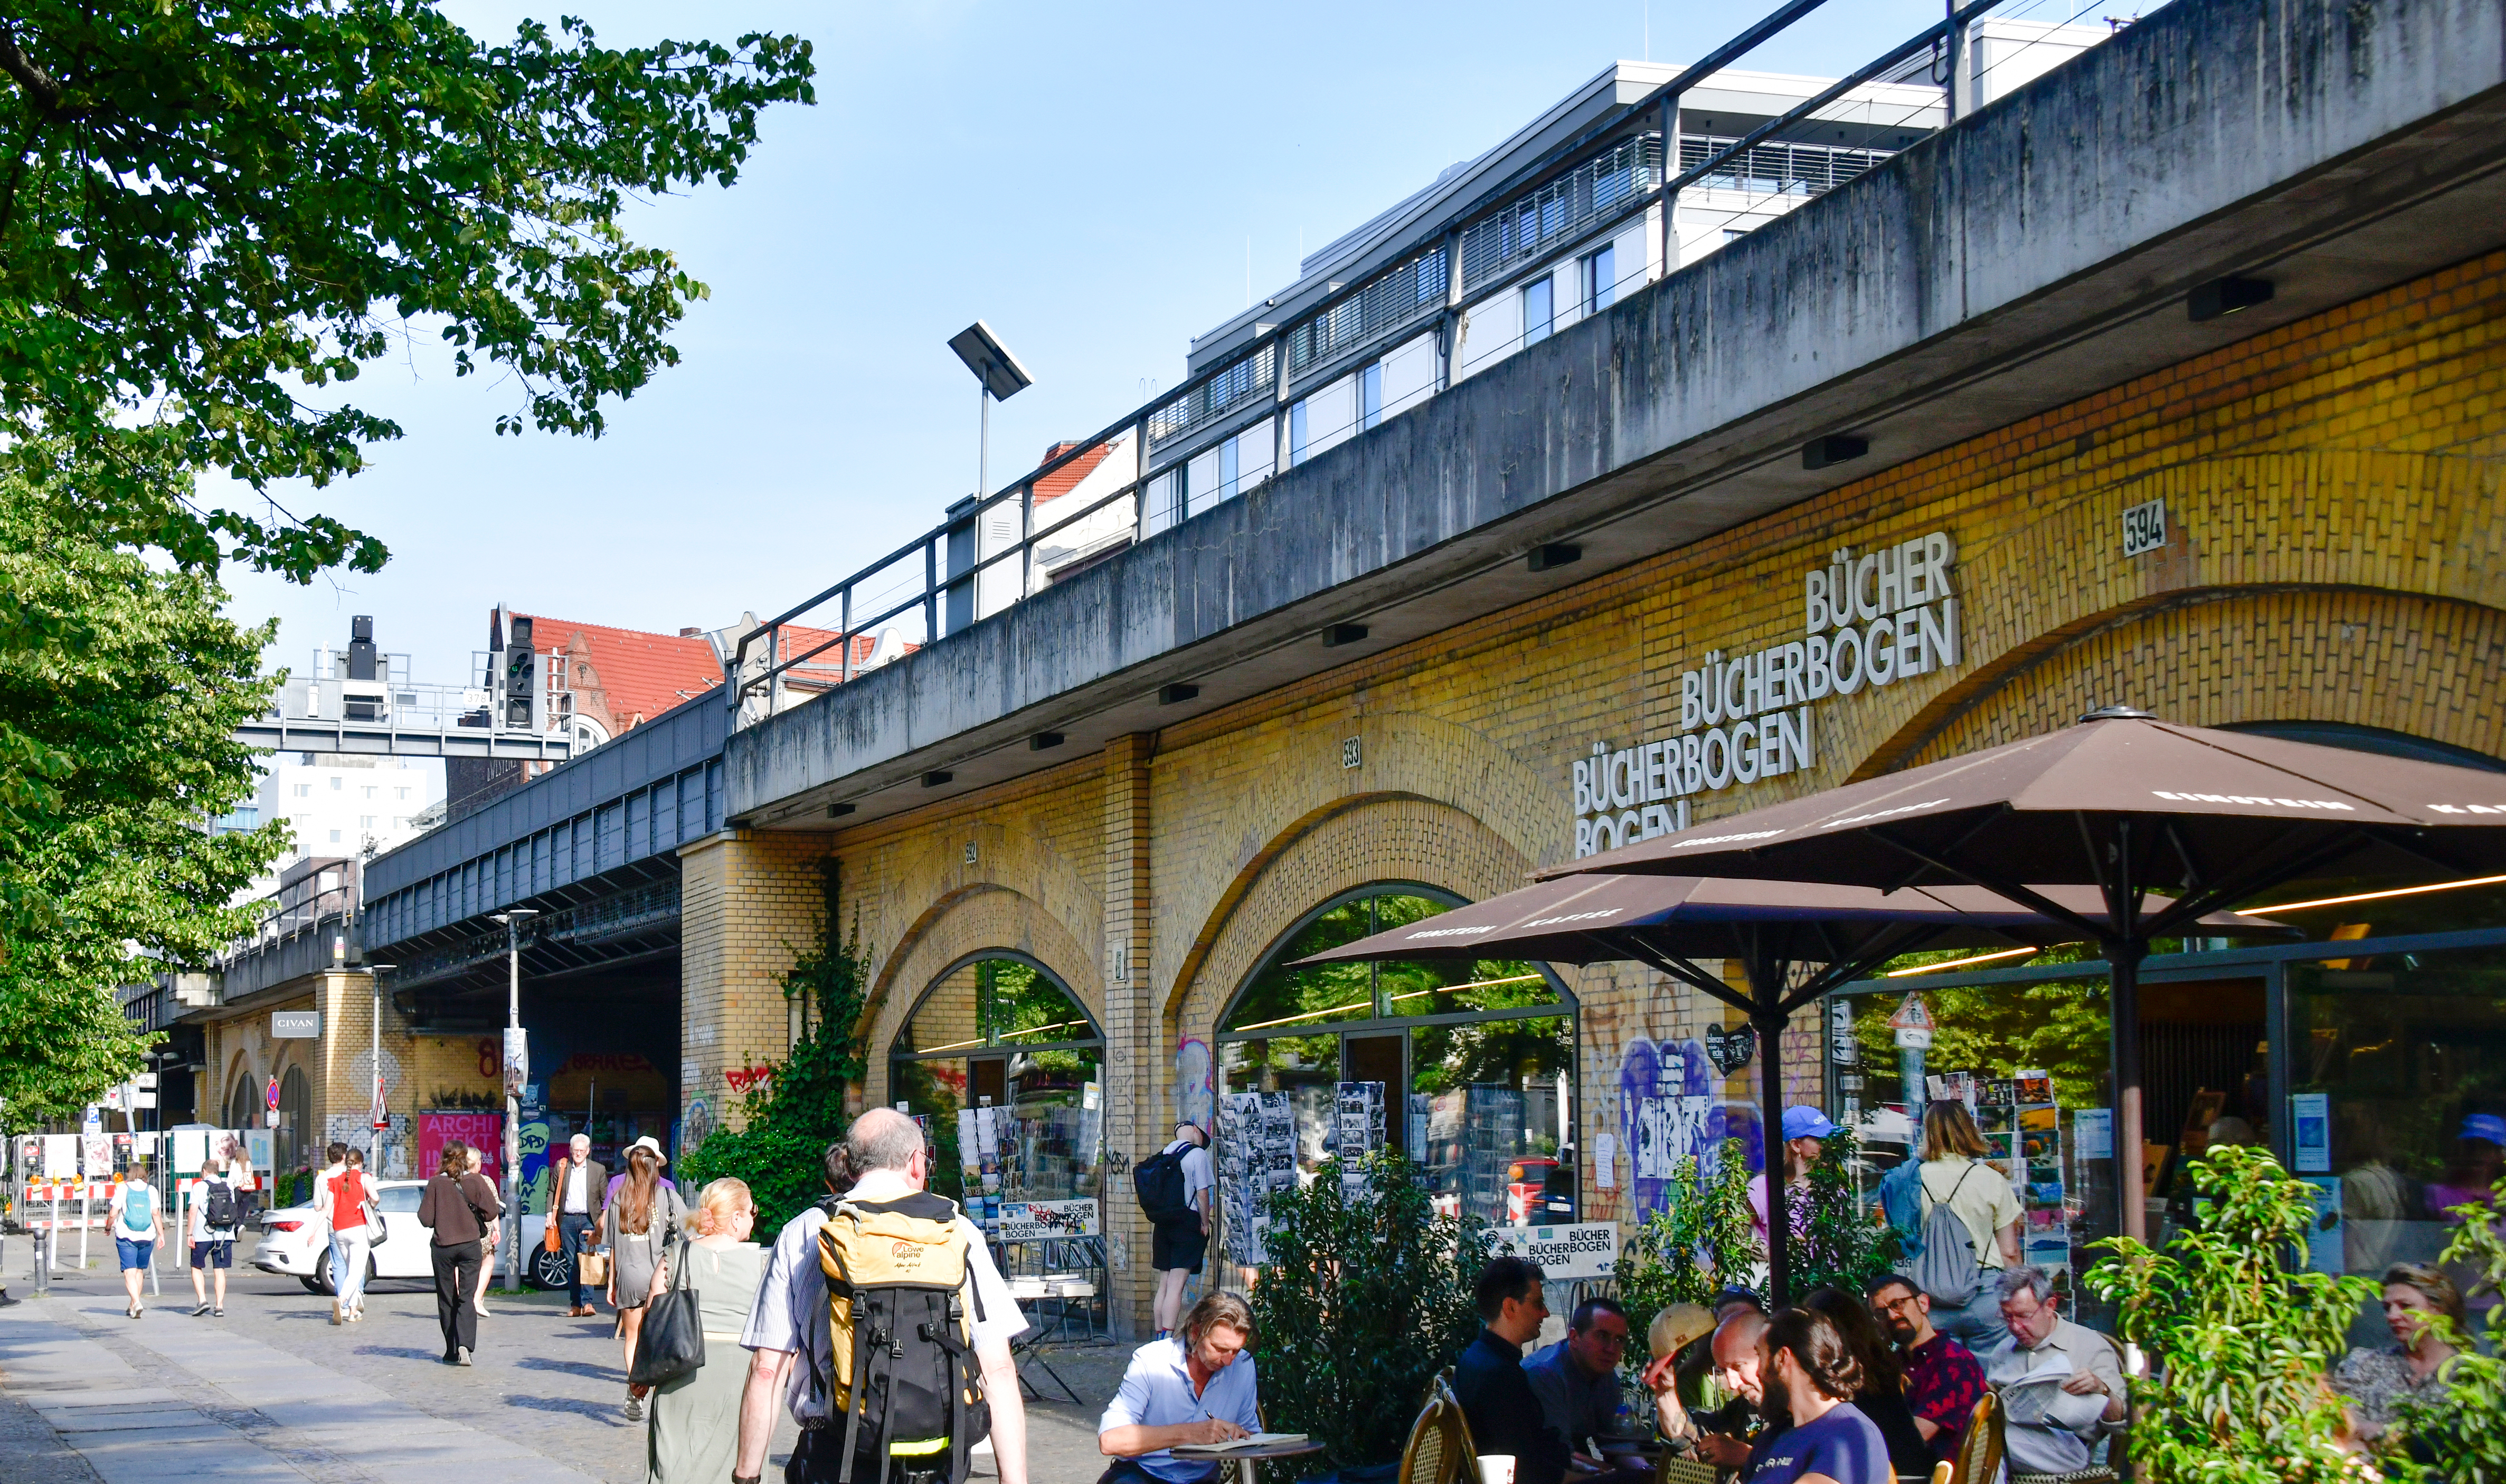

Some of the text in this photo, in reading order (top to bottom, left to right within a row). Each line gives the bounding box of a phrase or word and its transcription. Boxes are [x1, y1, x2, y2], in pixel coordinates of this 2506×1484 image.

[2126, 503, 2162, 551] 594
[1806, 531, 1956, 634] BÜCHER
[1681, 598, 1961, 730] BÜCHERBOGEN
[468, 694, 486, 702] 378
[1343, 739, 1359, 767] 593
[1573, 706, 1815, 815] BÜCHERBOGEN
[2152, 791, 2354, 811] EINSTEIN
[1575, 800, 1691, 861] BOGEN
[966, 842, 976, 862] 592
[1405, 908, 1623, 939] EINSTEIN KAFFEE
[277, 1019, 314, 1028] CIVAN
[427, 1116, 493, 1133] ARCHI
[1064, 1203, 1093, 1212] BÜCHER
[1006, 1230, 1035, 1238] BOGEN
[1569, 1229, 1610, 1241] BÜCHER
[896, 1251, 921, 1260] alpine
[1529, 1241, 1610, 1254] BÜCHERBOGEN
